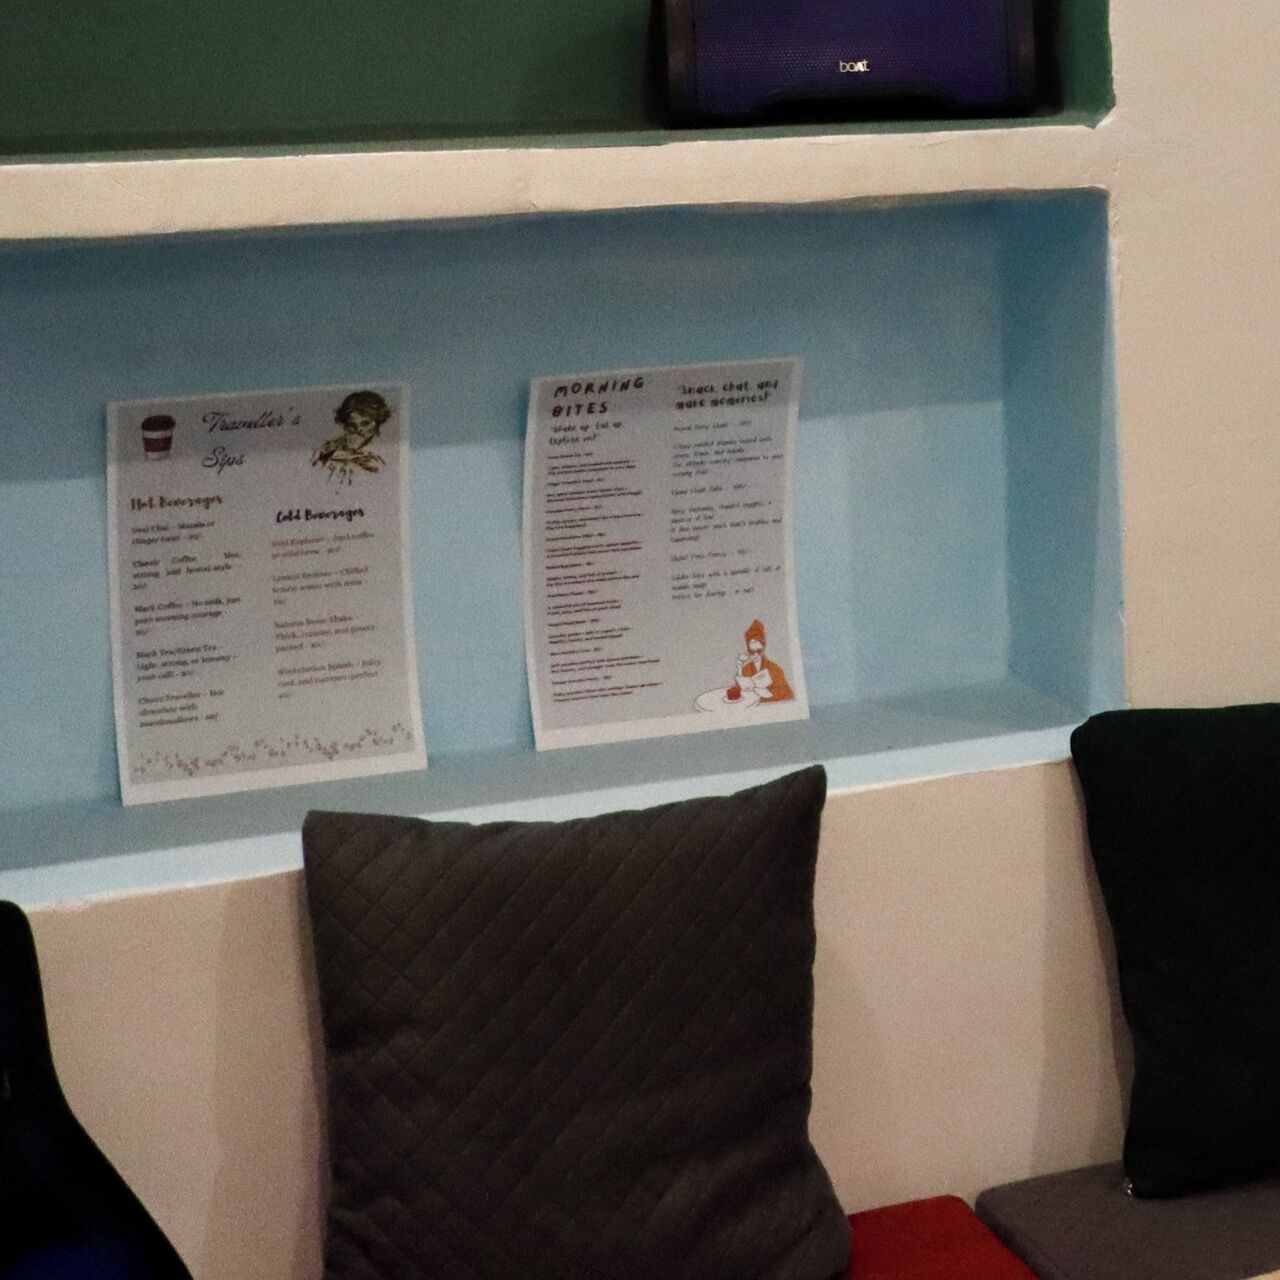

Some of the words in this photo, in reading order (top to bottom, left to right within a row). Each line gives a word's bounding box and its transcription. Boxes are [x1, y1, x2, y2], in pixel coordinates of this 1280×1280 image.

[839, 60, 870, 73] boAt
[554, 376, 645, 399] MORNING
[552, 401, 609, 418] BITES
[202, 406, 301, 432] Traveller's
[202, 446, 246, 474] Sips
[131, 496, 154, 511] Hot
[159, 494, 223, 509] Beverages
[276, 509, 301, 523] Cold
[305, 507, 365, 522] Beverages
